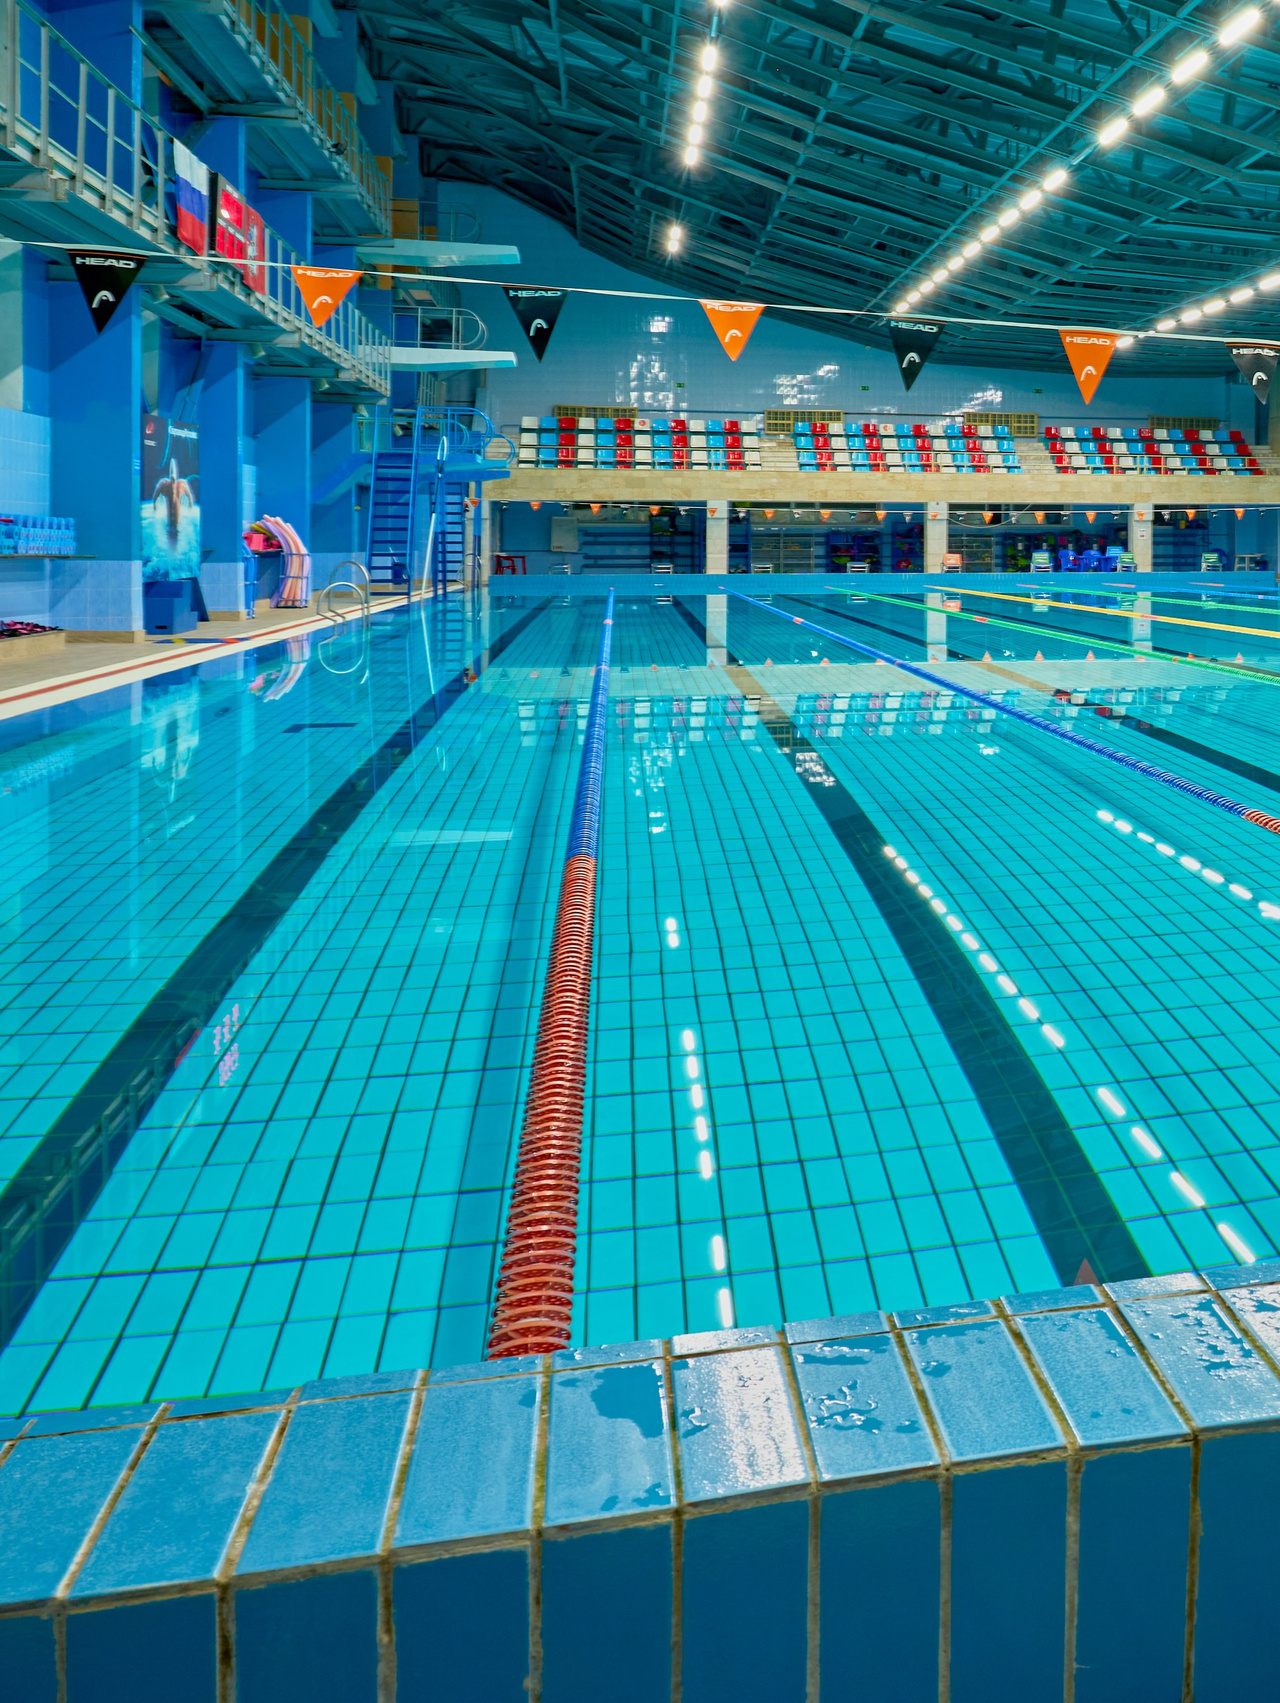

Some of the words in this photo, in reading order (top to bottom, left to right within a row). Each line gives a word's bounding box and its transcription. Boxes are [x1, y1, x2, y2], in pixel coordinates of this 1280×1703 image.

[75, 257, 137, 268] HEAD
[296, 269, 354, 278] HEAD
[706, 304, 757, 312] HEAD
[890, 320, 939, 333] HEAD
[1065, 336, 1110, 345] HEAD
[1232, 348, 1275, 357] HEAD
